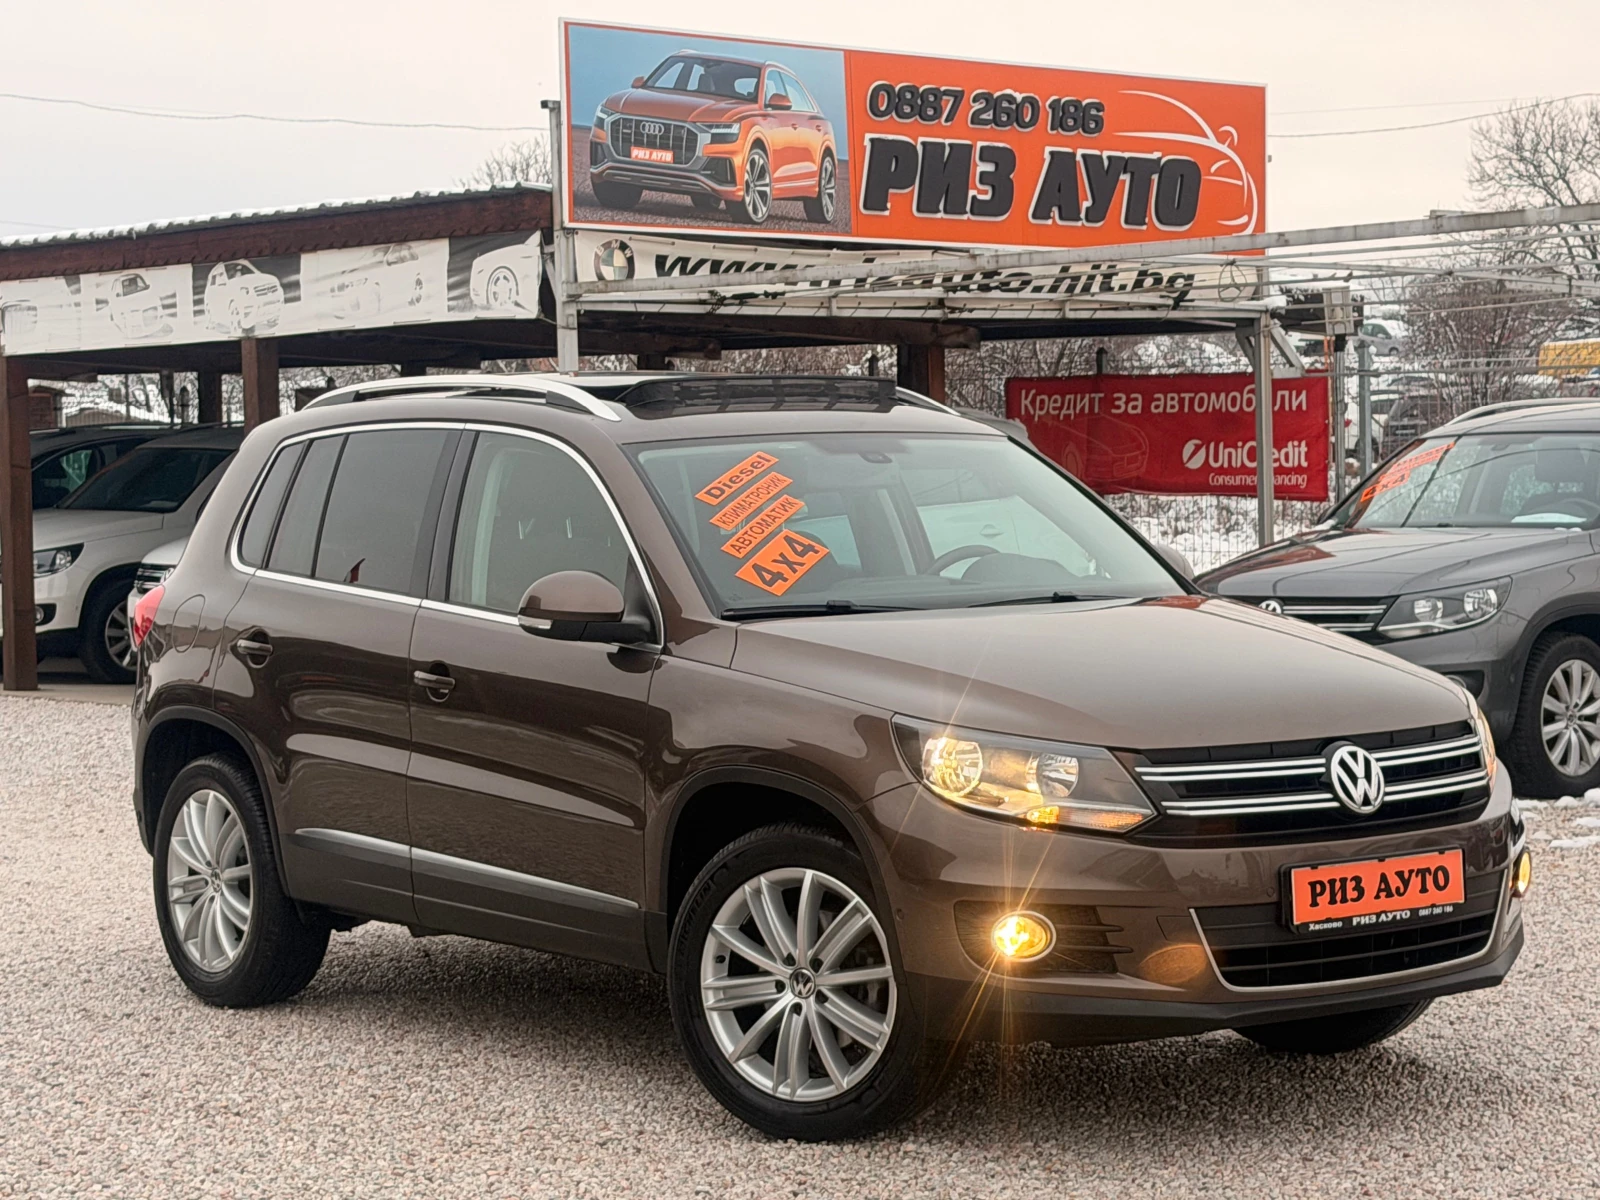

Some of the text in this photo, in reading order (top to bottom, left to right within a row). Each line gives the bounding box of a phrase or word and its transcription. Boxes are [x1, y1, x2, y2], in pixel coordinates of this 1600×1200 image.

[867, 80, 1106, 136] 0887 260 186
[631, 148, 672, 162] РИЗ АУТО
[861, 133, 1203, 232] РИЗ АУТО
[1020, 384, 1308, 422] Кредит за автомобли
[1208, 440, 1309, 469] UniCedit
[703, 454, 772, 500] Diesel
[1208, 472, 1260, 487] Consume
[716, 474, 787, 527] КЛИМАТРОНИК
[729, 497, 799, 555] АВТОМАТИК
[751, 534, 821, 588] 4x4
[1307, 865, 1450, 908] РИЗ АУТО
[1308, 920, 1343, 932] Хасково
[1351, 914, 1377, 927] РИЗ
[1379, 909, 1411, 922] АУТО
